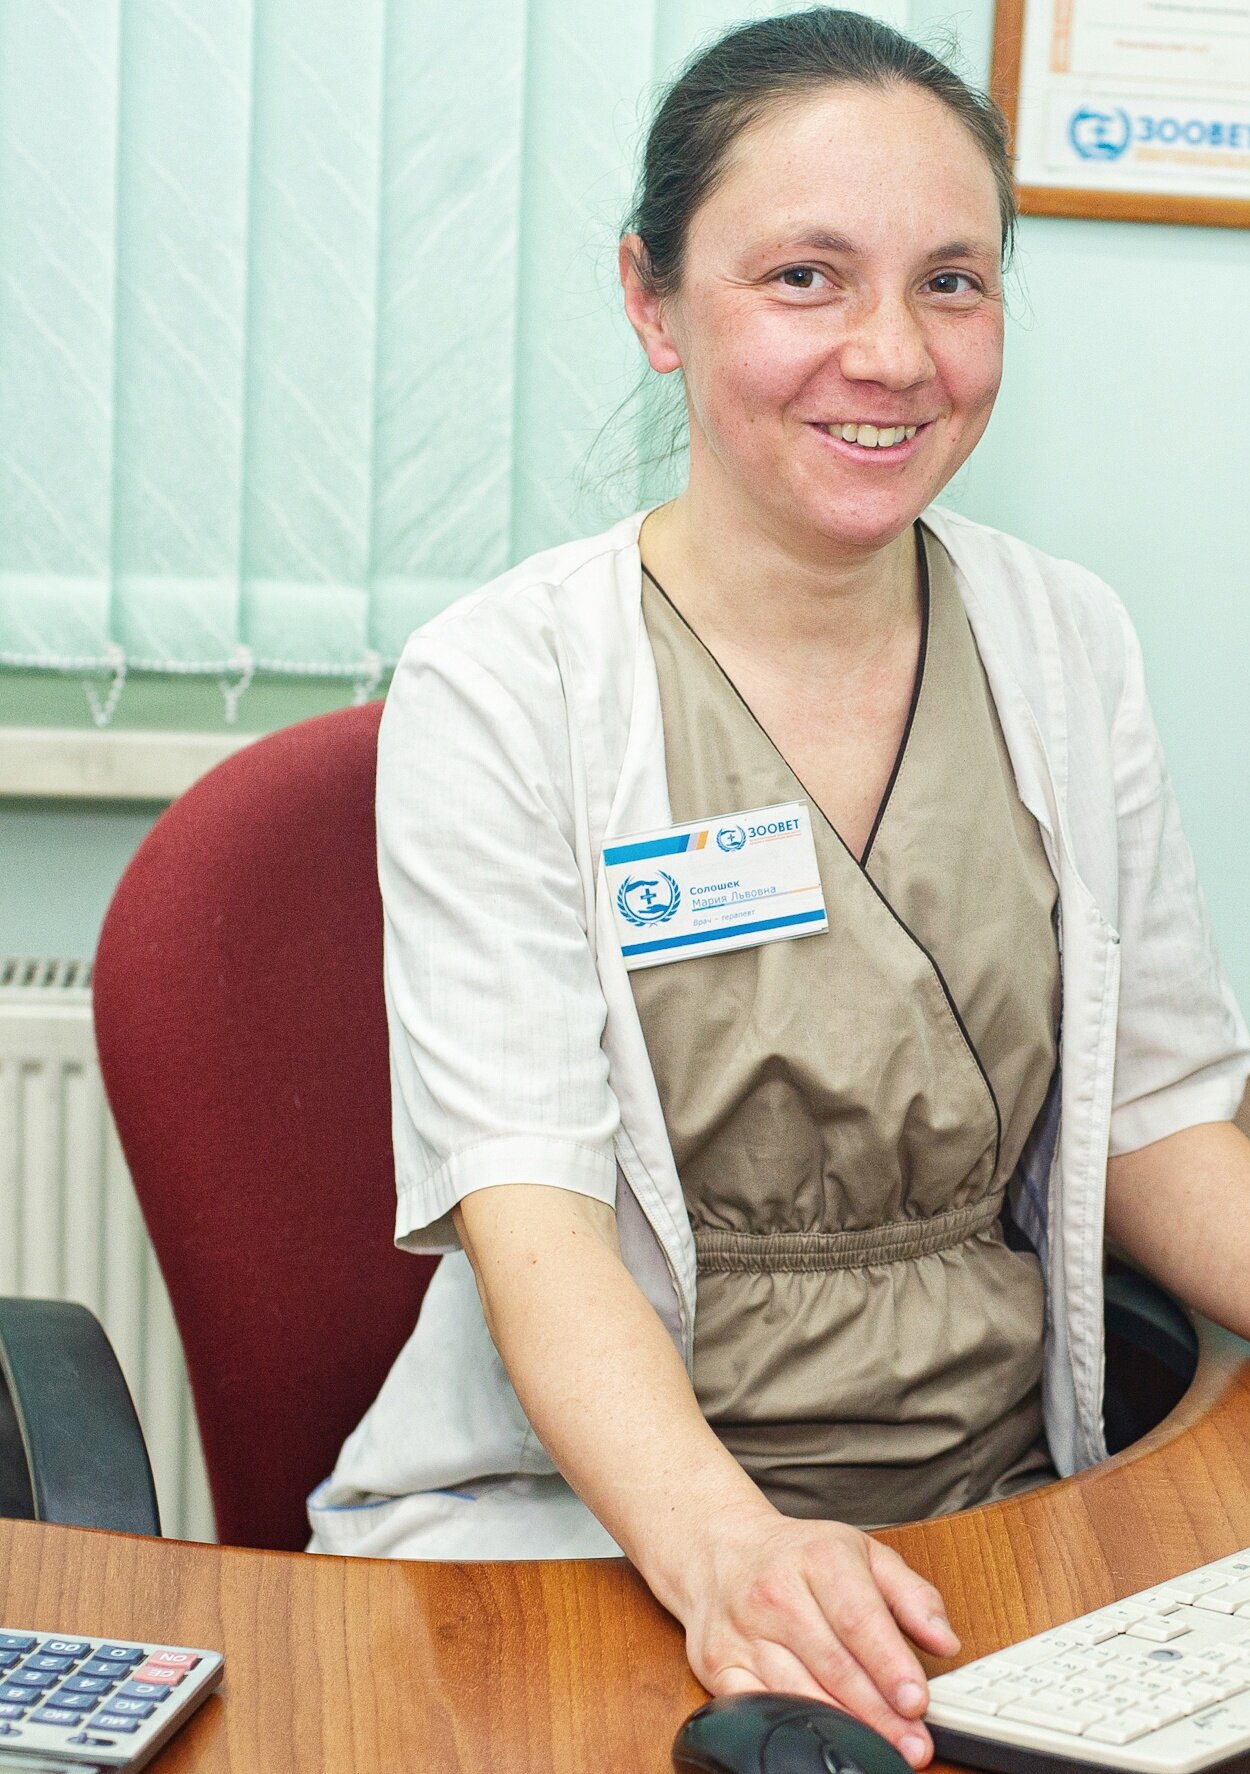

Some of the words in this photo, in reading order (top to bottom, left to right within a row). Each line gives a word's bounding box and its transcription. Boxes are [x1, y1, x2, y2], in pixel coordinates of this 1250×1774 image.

[748, 818, 799, 838] ЗООВЕТ
[690, 880, 740, 896] Солошек
[692, 895, 728, 909] Мария
[731, 885, 777, 901] Львовна
[693, 917, 712, 927] Врач
[721, 909, 756, 922] терапевт
[50, 1641, 80, 1652] 00
[110, 1649, 127, 1657] 0
[160, 1653, 188, 1662] ON
[39, 1659, 59, 1667] 2
[98, 1664, 110, 1672] 1
[149, 1669, 175, 1678] CE
[79, 1679, 97, 1688] 4
[136, 1685, 155, 1693] C
[115, 1702, 144, 1710] AC
[101, 1716, 128, 1725] MU
